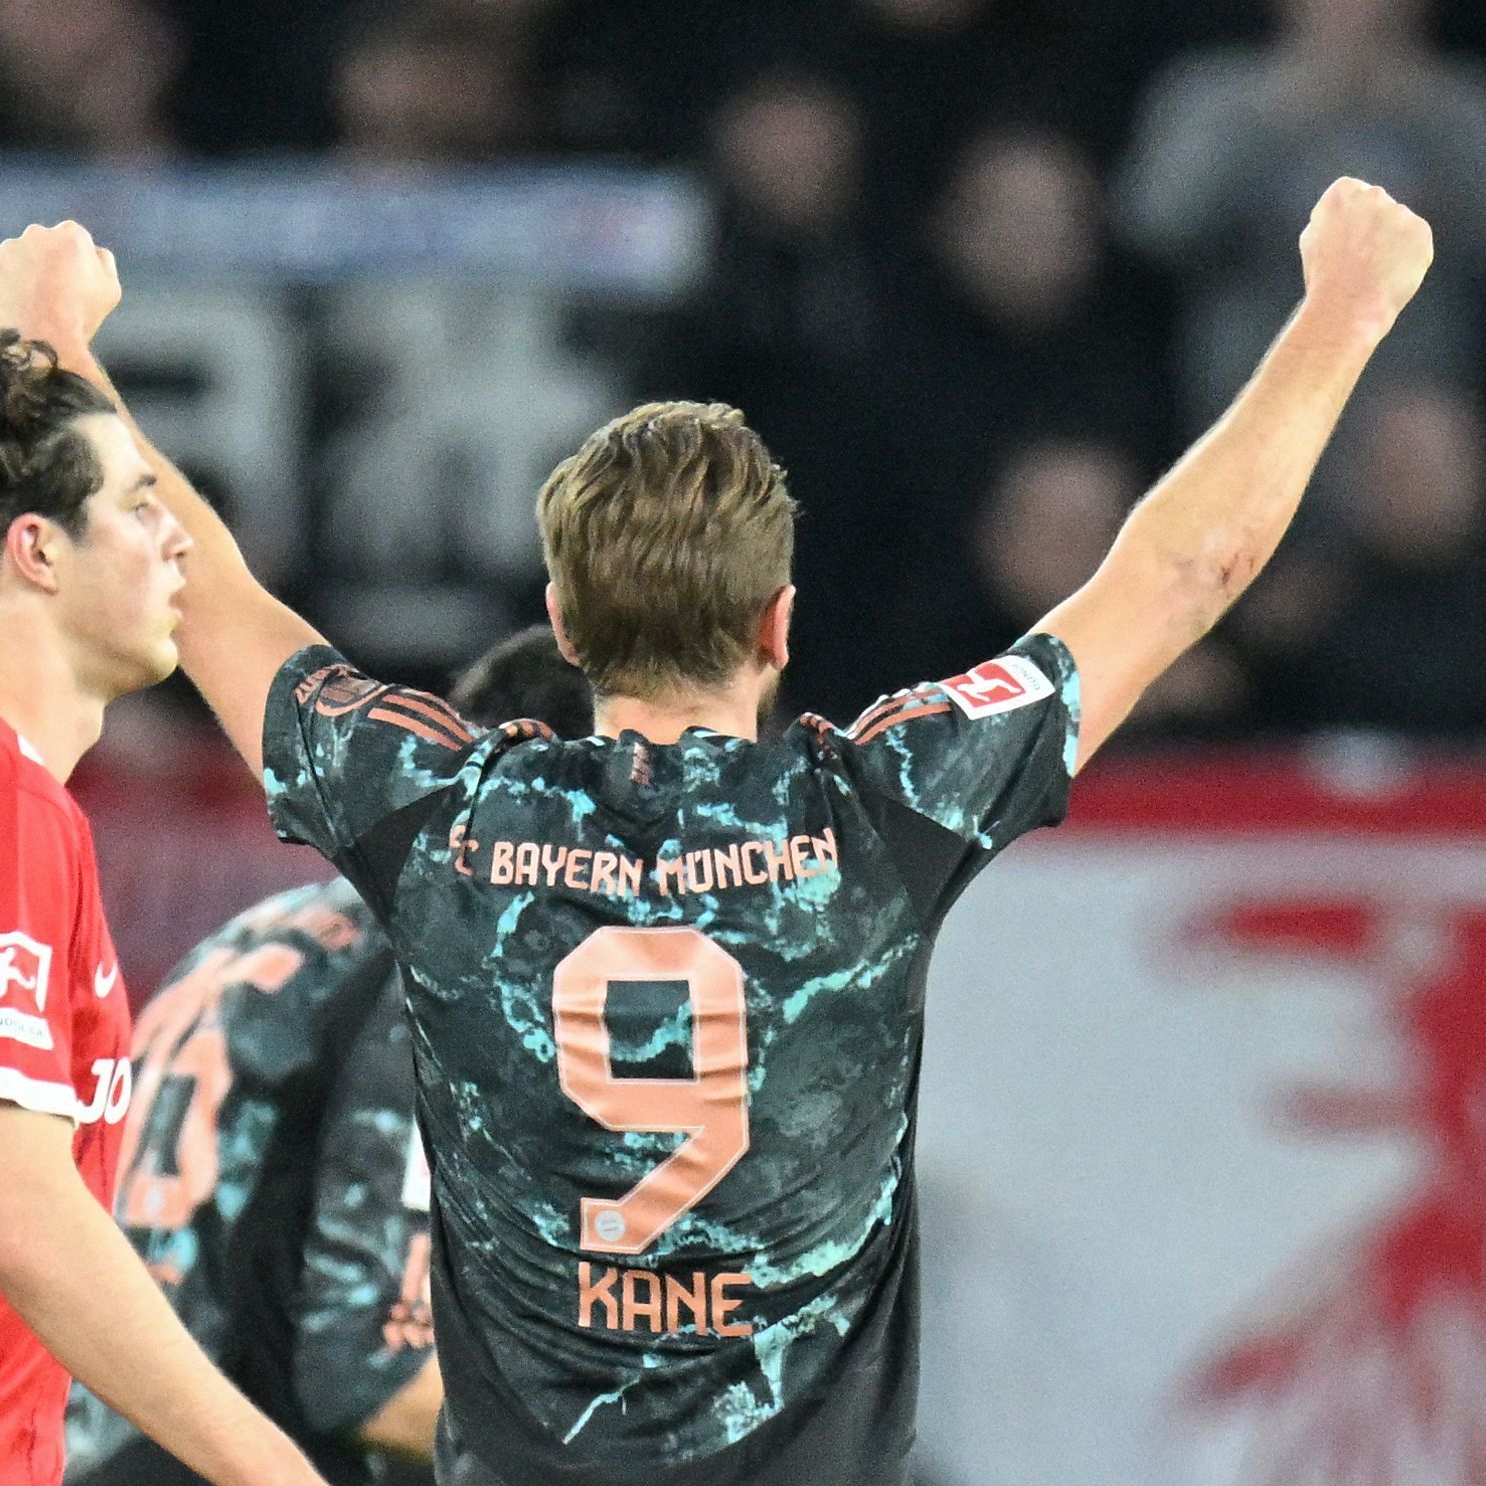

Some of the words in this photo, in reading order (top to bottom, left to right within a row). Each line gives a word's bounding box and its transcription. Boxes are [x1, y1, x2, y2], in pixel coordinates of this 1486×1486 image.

[490, 840, 644, 897] BAYERN
[657, 827, 839, 897] MÜNCHEN
[552, 925, 749, 1255] 9
[577, 1261, 754, 1338] KANE
